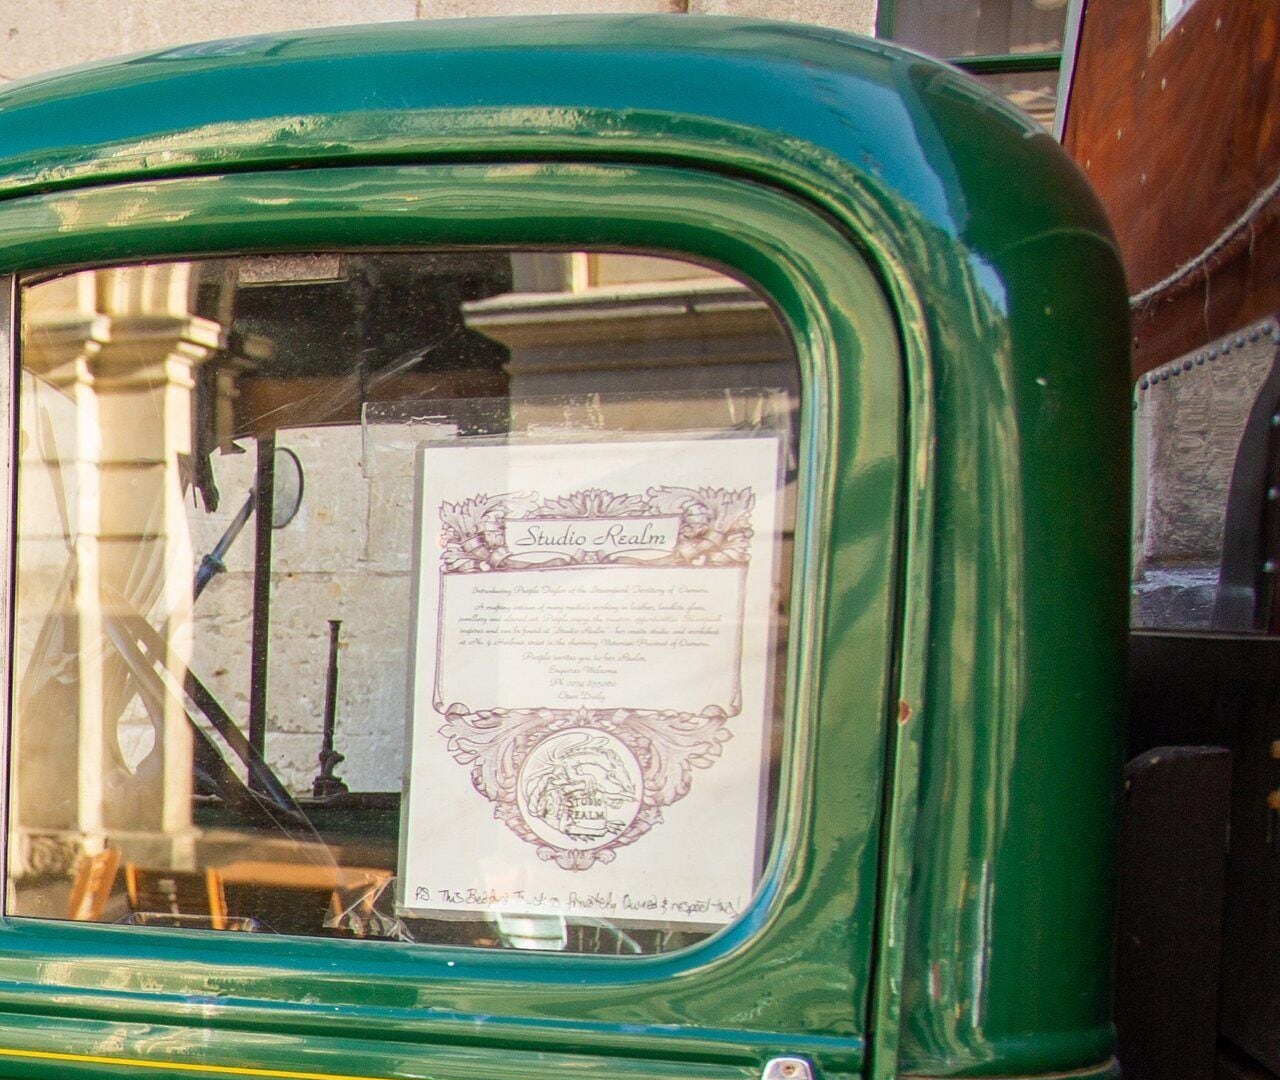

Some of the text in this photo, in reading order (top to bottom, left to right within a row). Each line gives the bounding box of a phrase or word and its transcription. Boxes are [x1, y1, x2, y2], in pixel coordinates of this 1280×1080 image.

[515, 522, 668, 547] Studio Realm
[566, 809, 606, 825] REALM
